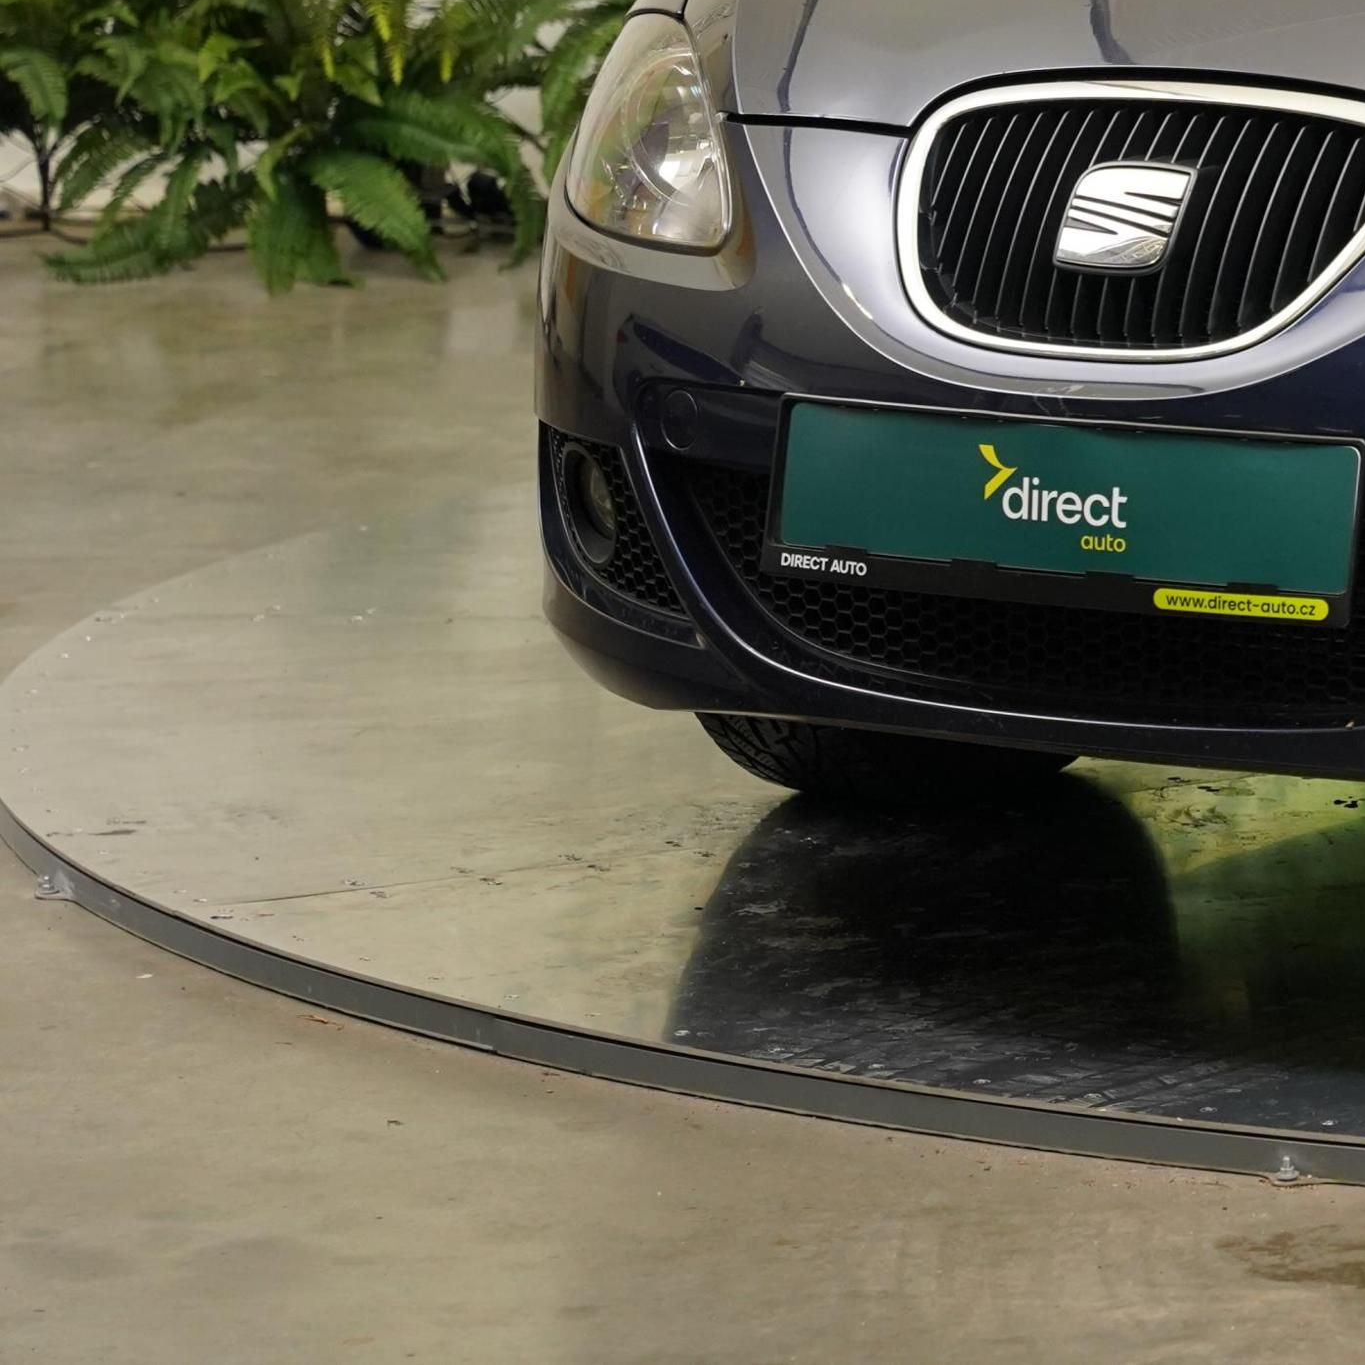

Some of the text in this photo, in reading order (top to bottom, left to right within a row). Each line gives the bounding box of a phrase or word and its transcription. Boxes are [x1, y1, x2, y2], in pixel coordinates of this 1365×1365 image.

[1002, 477, 1128, 528] direct
[1080, 534, 1126, 553] auto
[780, 552, 867, 576] DIRECT AUTO
[1166, 594, 1316, 616] www.direct-auto.cz
